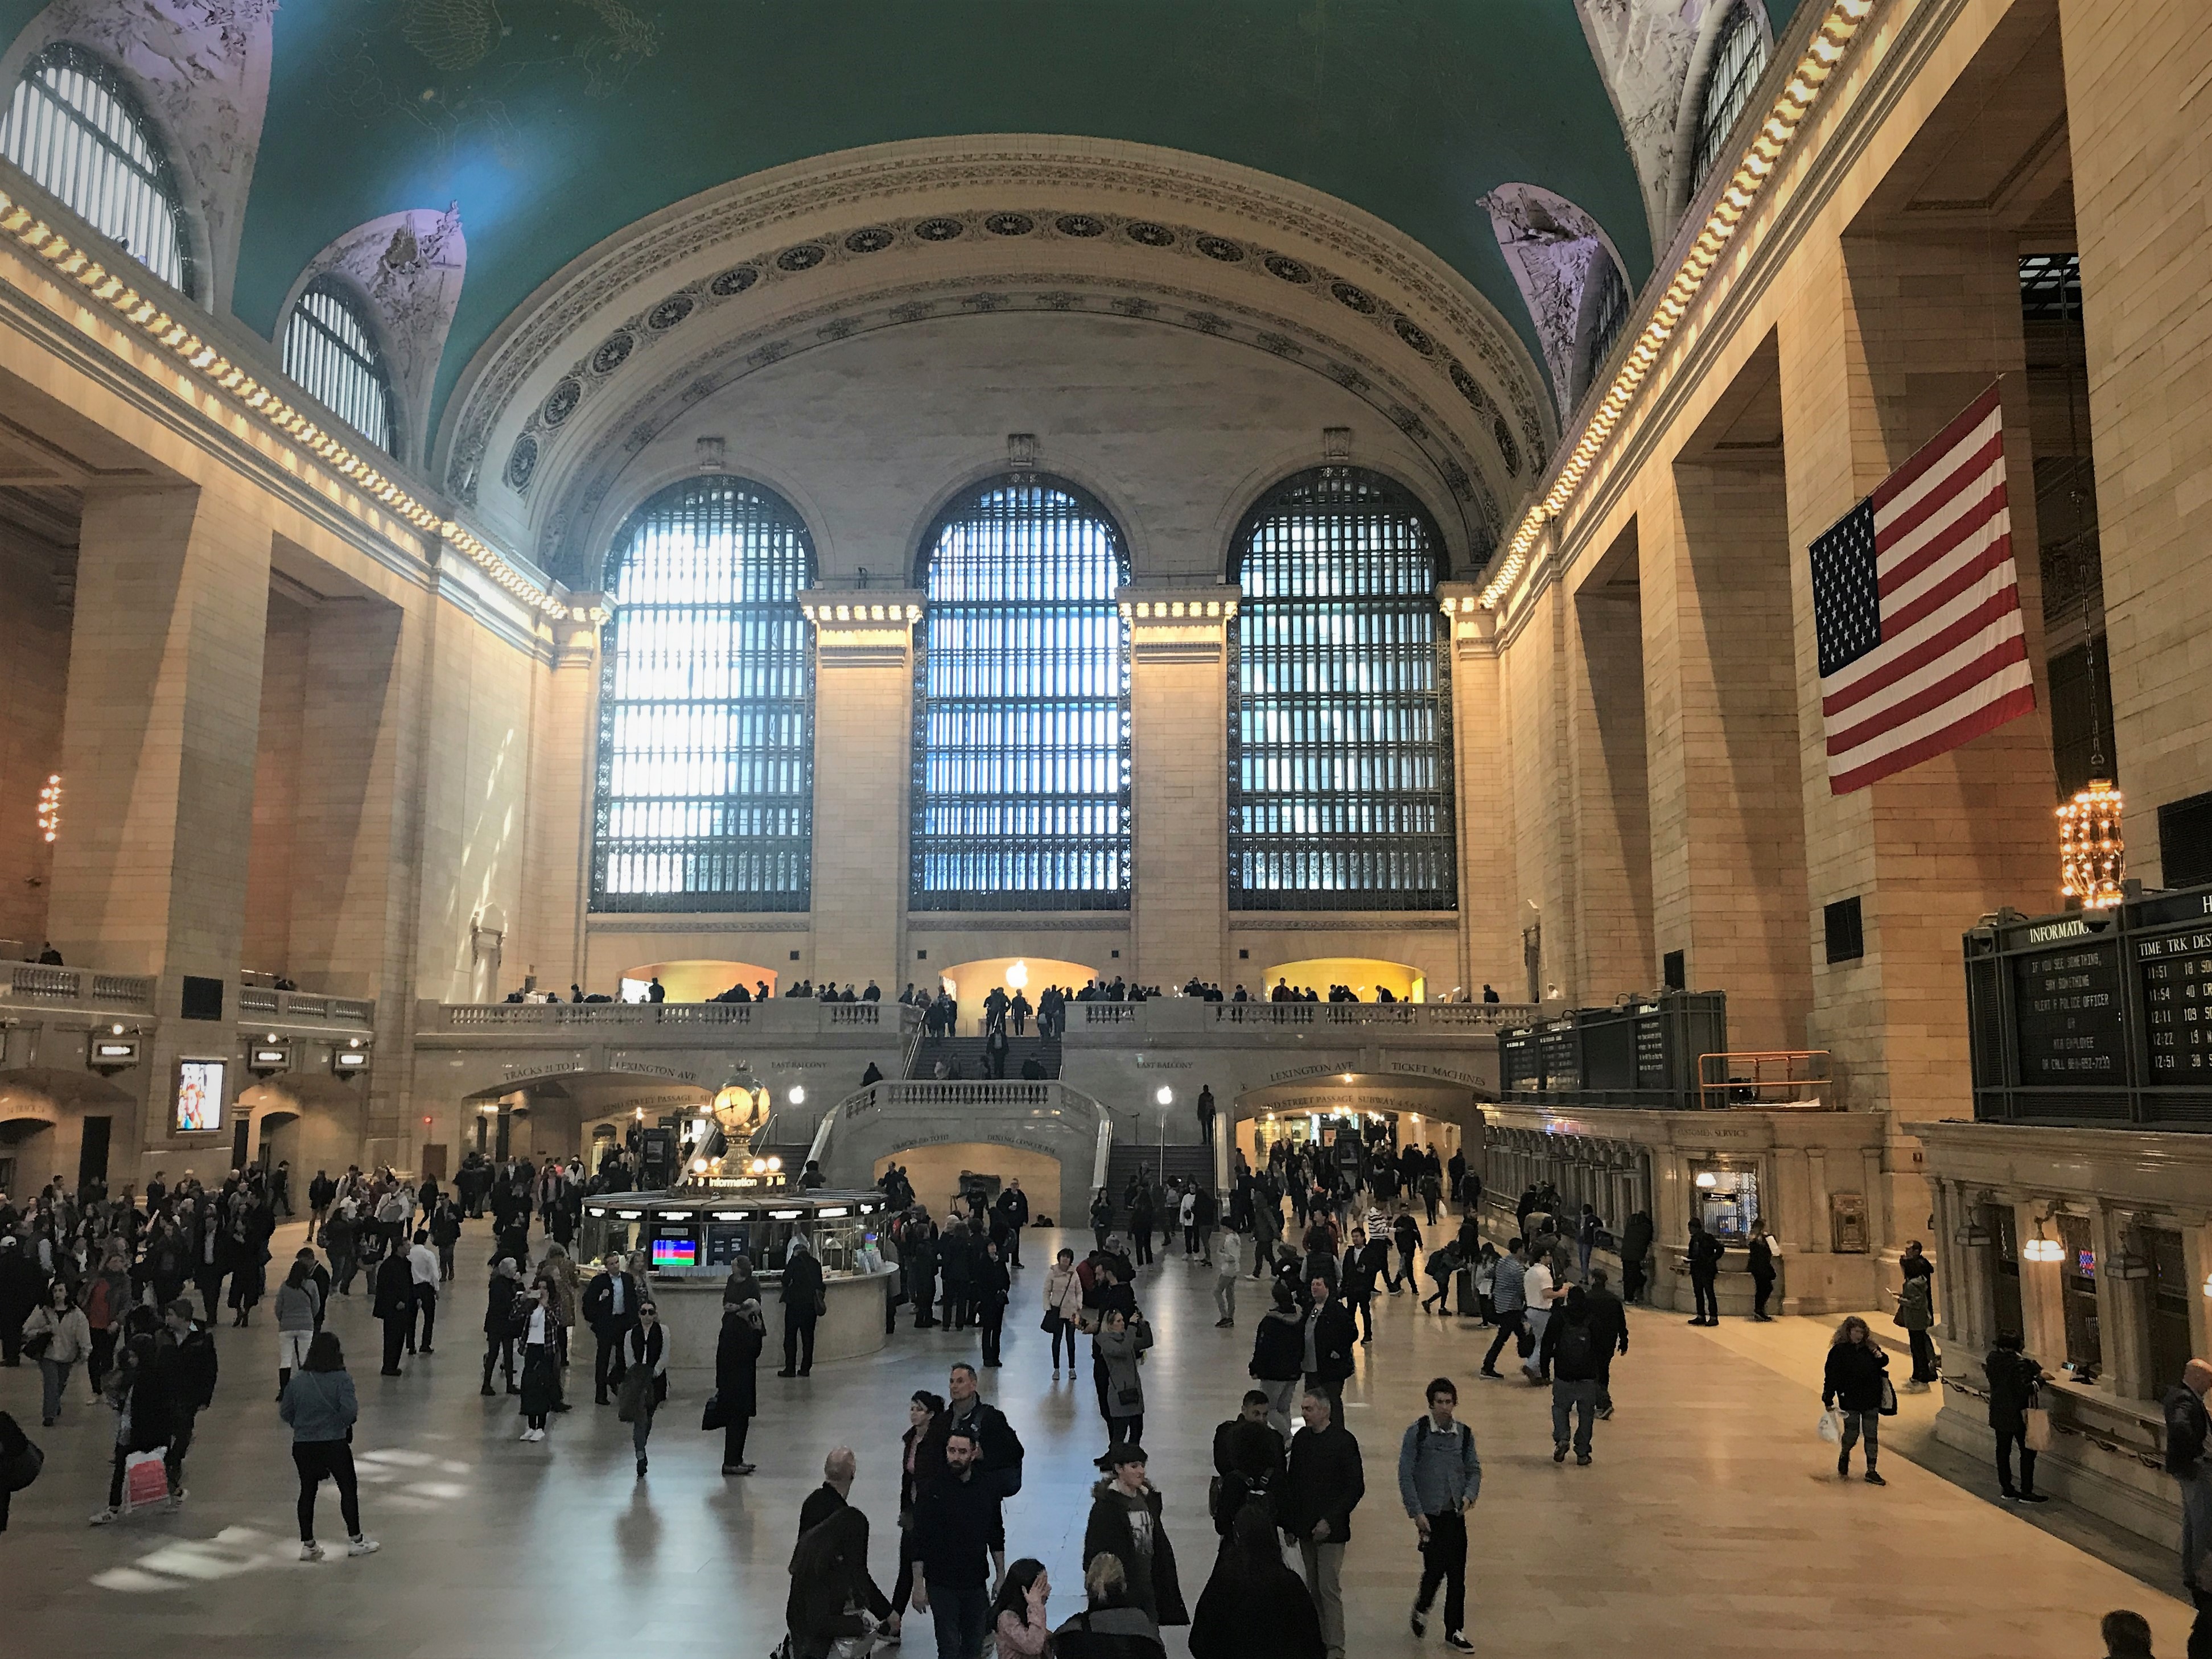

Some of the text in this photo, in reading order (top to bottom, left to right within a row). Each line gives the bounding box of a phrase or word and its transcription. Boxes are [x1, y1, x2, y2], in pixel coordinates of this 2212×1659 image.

[2030, 920, 2092, 943] INFORMATIO
[2139, 941, 2162, 956] TIME
[2166, 937, 2188, 952] TRK
[2147, 965, 2168, 979] 11:51
[2083, 993, 2109, 1008] OFFICER
[2149, 987, 2170, 1001] 11:54
[2186, 985, 2195, 998] 40
[2151, 1010, 2171, 1023] 12:11
[2153, 1032, 2174, 1045] 12:22
[2155, 1055, 2175, 1068] 12:51
[503, 1066, 542, 1080] TRACKS
[556, 1063, 569, 1071] TO
[616, 1061, 697, 1081] LEXINGTON AVE
[1270, 1061, 1354, 1081] LEXINGTON AVE
[1391, 1062, 1485, 1086] TICKET MACHINES
[626, 1096, 654, 1106] STREET
[1282, 1097, 1314, 1106] STREET
[1358, 1095, 1394, 1106] SUBWAY
[891, 1139, 917, 1150] TRACKS
[987, 1134, 1056, 1154] DINING CONCOURSE
[709, 1176, 757, 1187] Information
